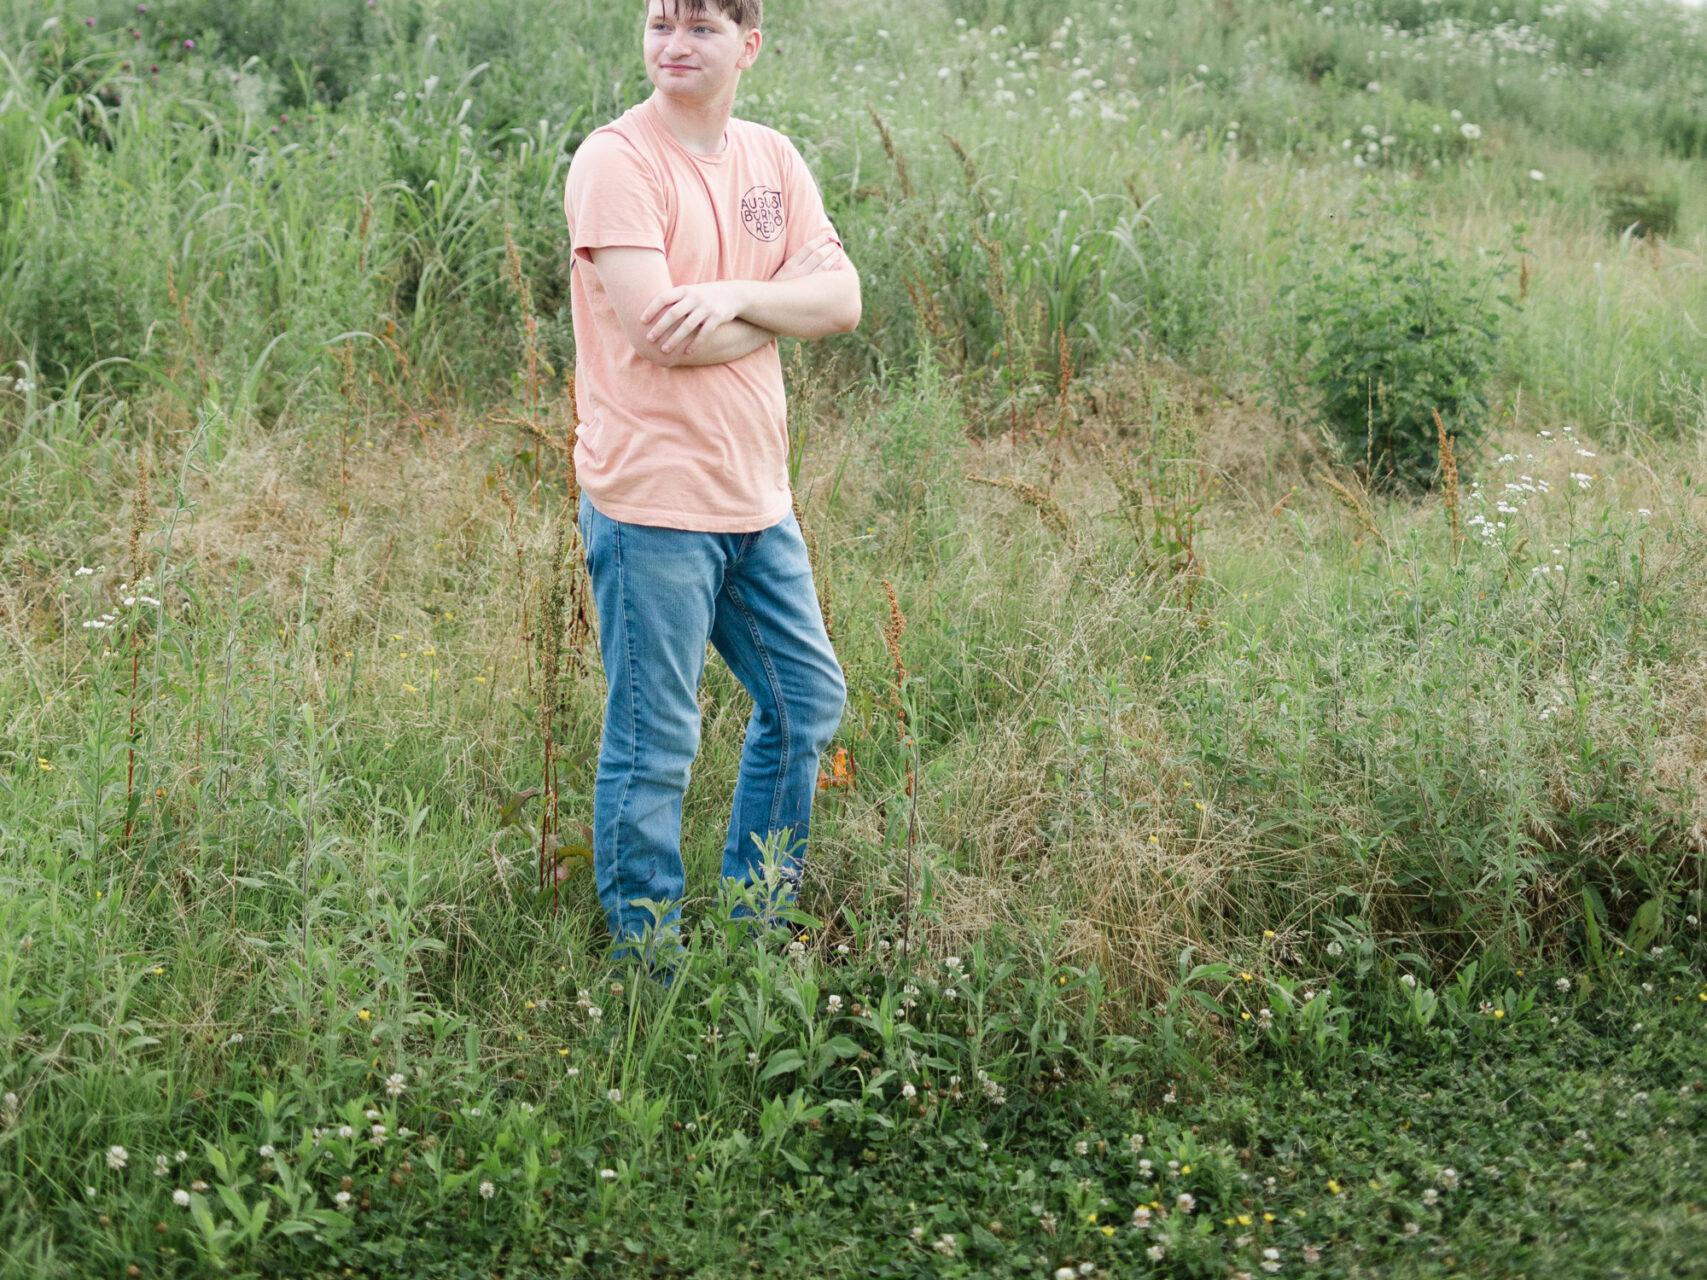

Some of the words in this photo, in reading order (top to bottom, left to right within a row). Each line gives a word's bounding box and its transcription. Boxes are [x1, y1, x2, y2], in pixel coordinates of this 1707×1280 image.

[741, 191, 782, 211] AUGUST
[744, 209, 783, 226] BURNS
[756, 221, 775, 238] RED
